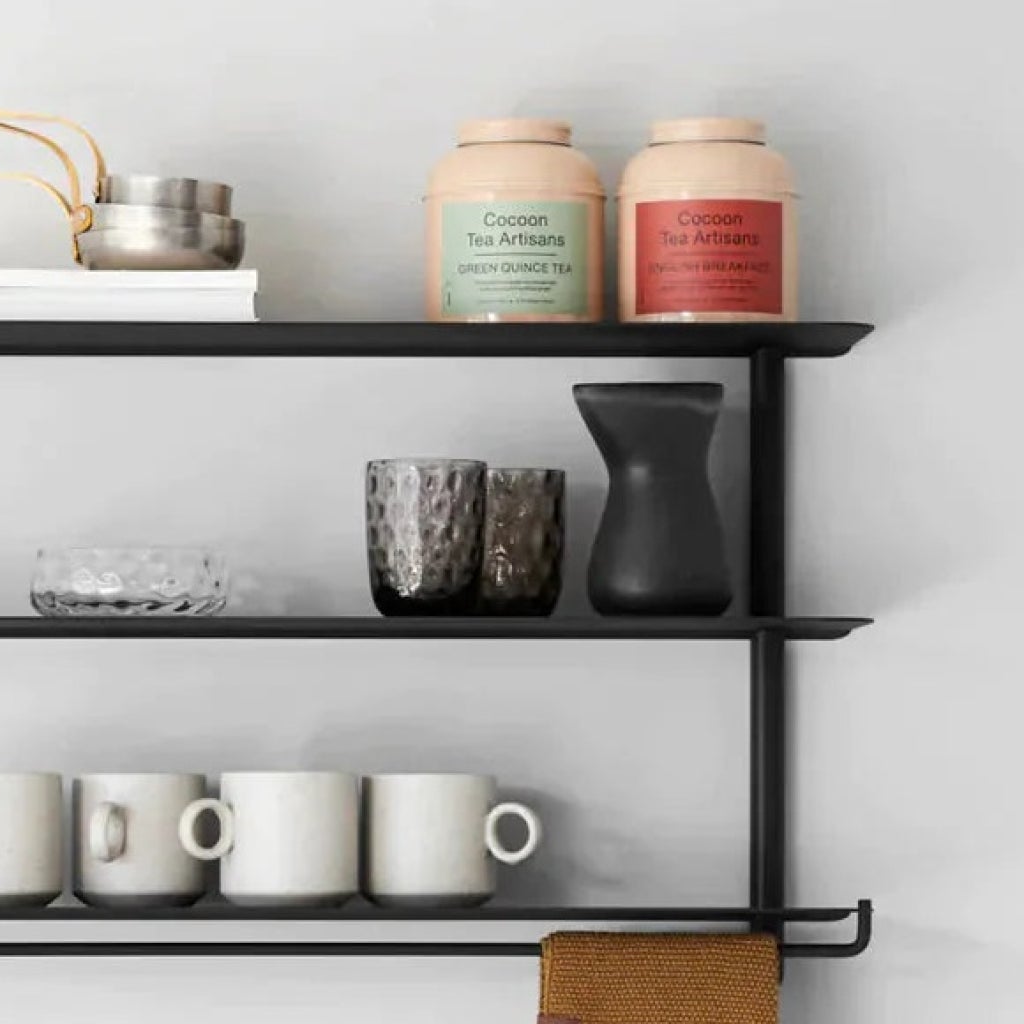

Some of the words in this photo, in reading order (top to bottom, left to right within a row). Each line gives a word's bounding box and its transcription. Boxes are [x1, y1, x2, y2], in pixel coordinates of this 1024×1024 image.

[483, 211, 548, 227] Cocoon
[678, 210, 743, 226] Cocoon
[466, 232, 494, 248] Tea
[499, 232, 566, 247] Artisans
[661, 231, 689, 246] Tea
[693, 230, 761, 246] Artisans
[457, 263, 497, 275] GREEN
[500, 262, 549, 273] QUINCE
[552, 262, 573, 275] TEA
